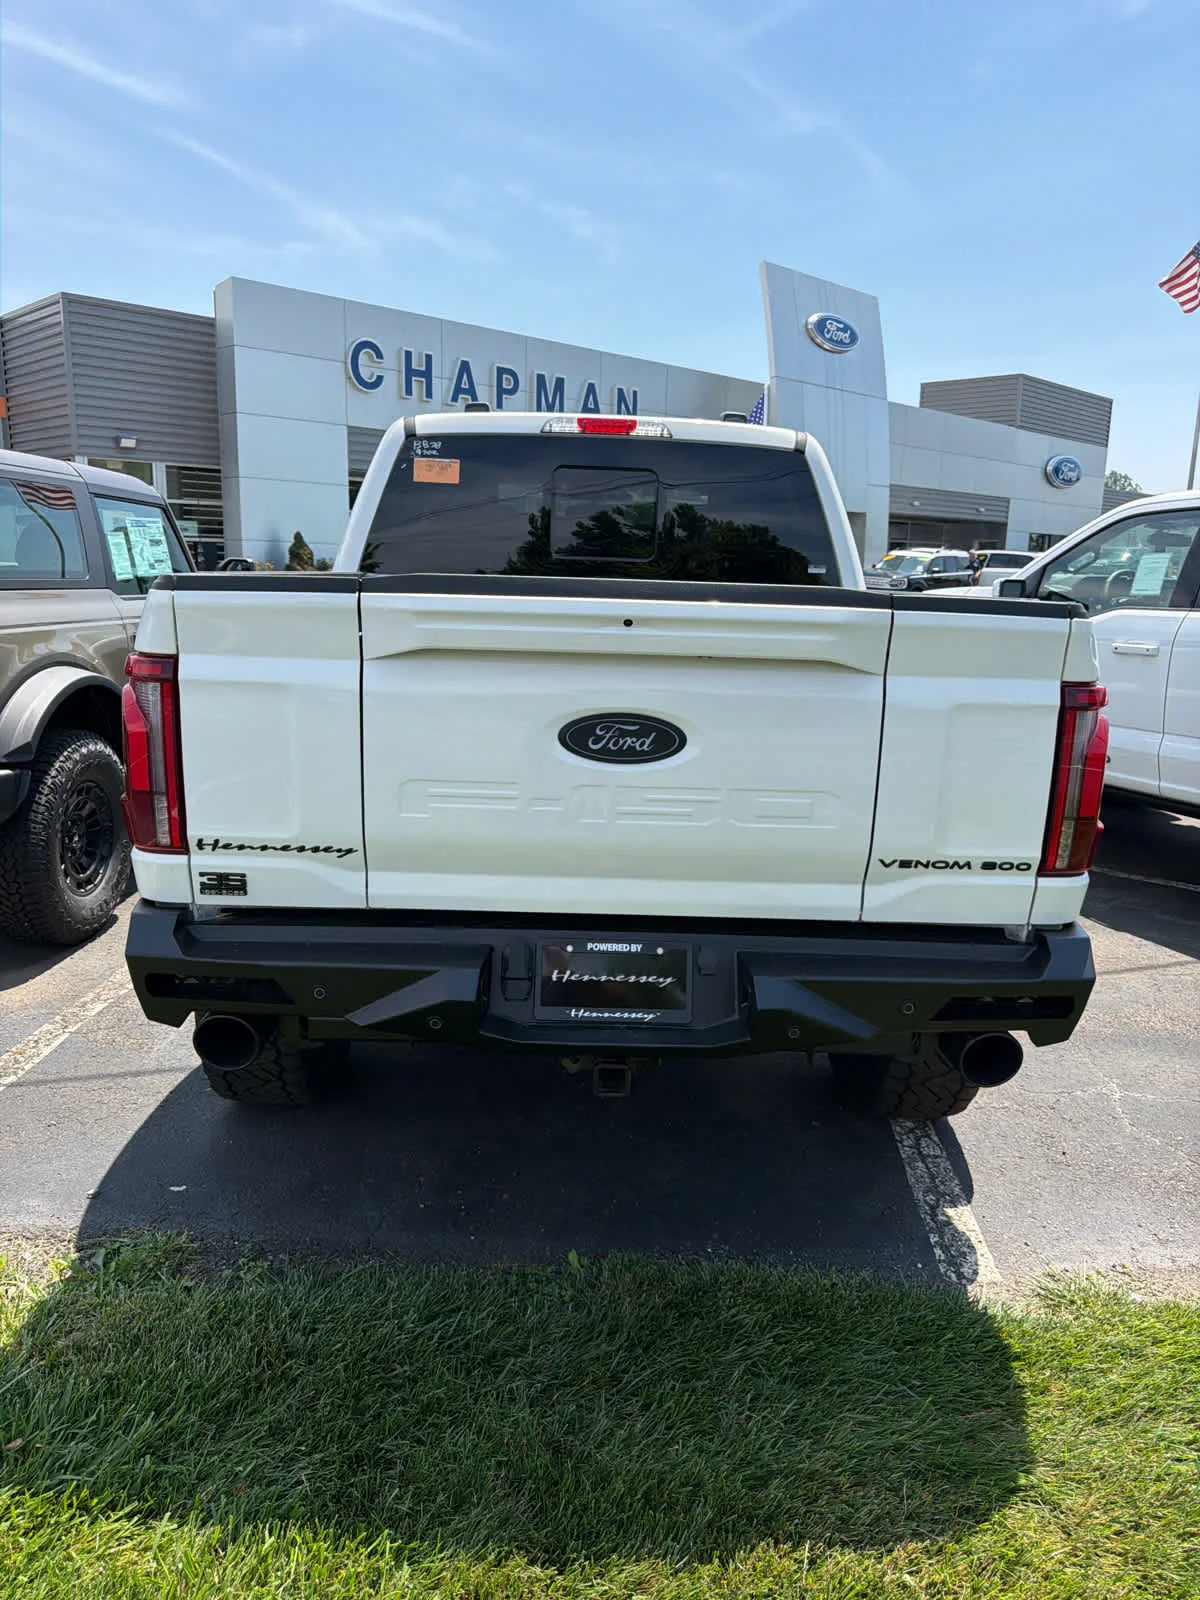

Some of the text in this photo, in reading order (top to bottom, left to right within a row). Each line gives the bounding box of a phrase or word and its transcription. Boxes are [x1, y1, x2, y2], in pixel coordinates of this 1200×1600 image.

[824, 320, 851, 343] Ford
[348, 339, 639, 416] CHAPMAN
[1059, 463, 1078, 481] Ford
[588, 722, 656, 752] Ford
[399, 779, 841, 829] F-150
[196, 838, 358, 858] Hennessey
[878, 859, 972, 870] VENOM
[587, 942, 643, 952] POWERED BY
[551, 969, 677, 988] Hennessey
[570, 1008, 656, 1022] Hennessey
